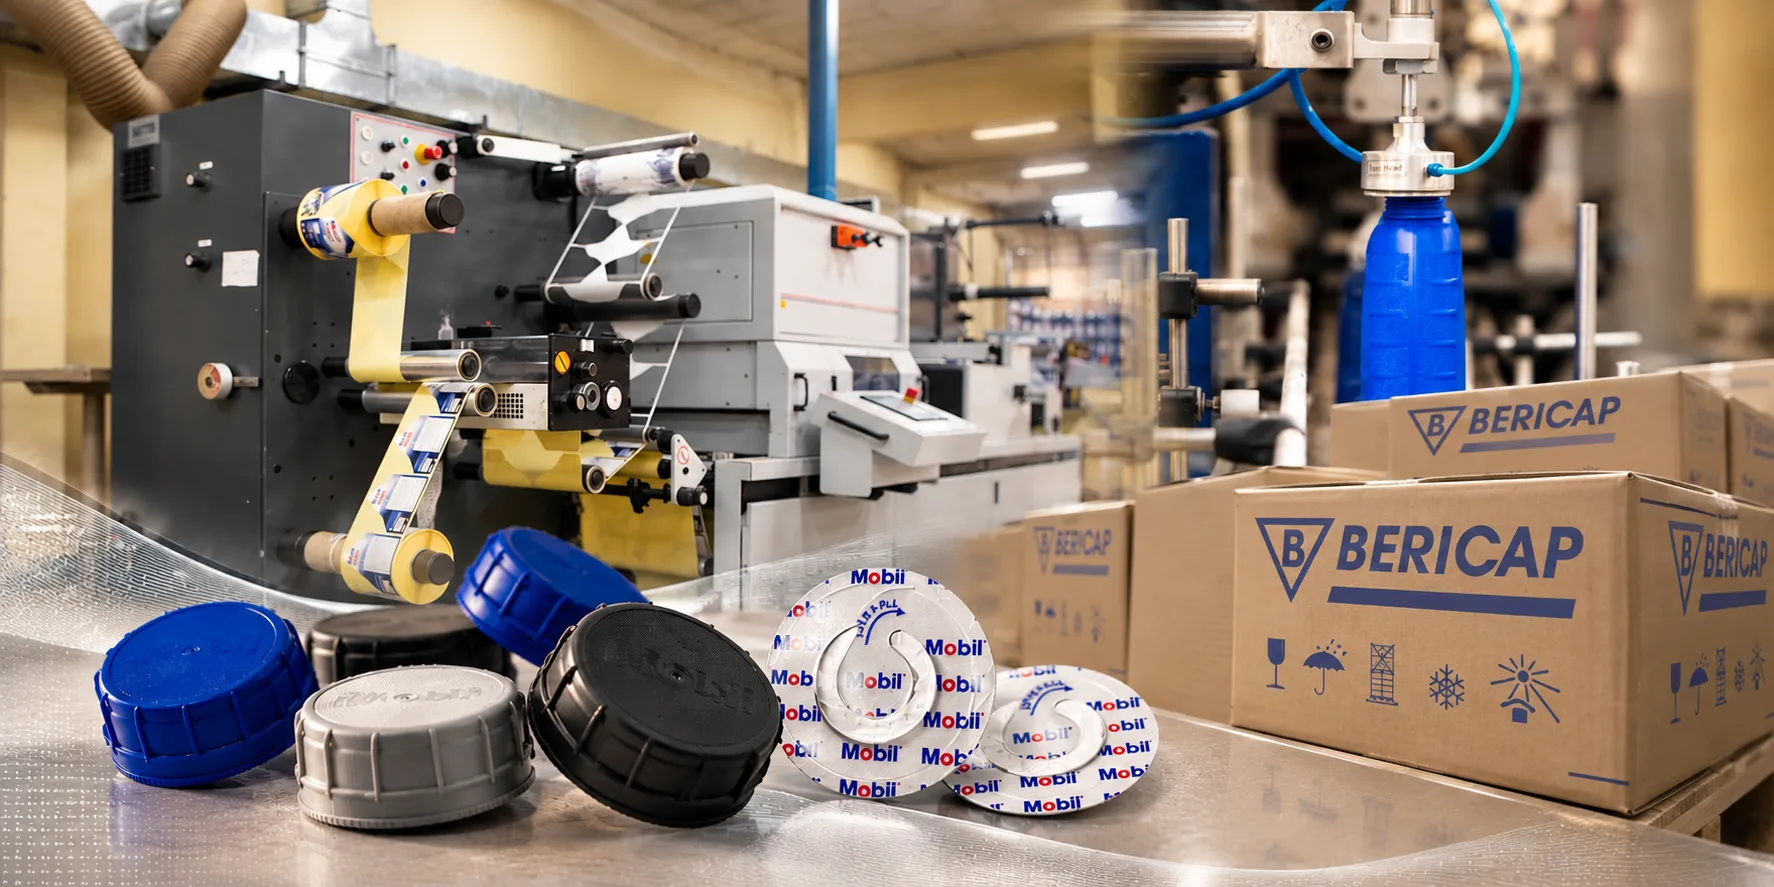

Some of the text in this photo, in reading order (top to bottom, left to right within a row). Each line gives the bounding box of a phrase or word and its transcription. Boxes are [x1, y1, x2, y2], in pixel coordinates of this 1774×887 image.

[1427, 396, 1621, 436] B BERICAP
[1282, 525, 1585, 579] B BERICAP
[1680, 533, 1768, 578] B BERICAP
[925, 639, 983, 656] Mobil
[846, 672, 902, 690] Mobil
[841, 743, 898, 762] Mobil
[1098, 740, 1150, 756] Mobil
[1020, 772, 1076, 788] Mobil
